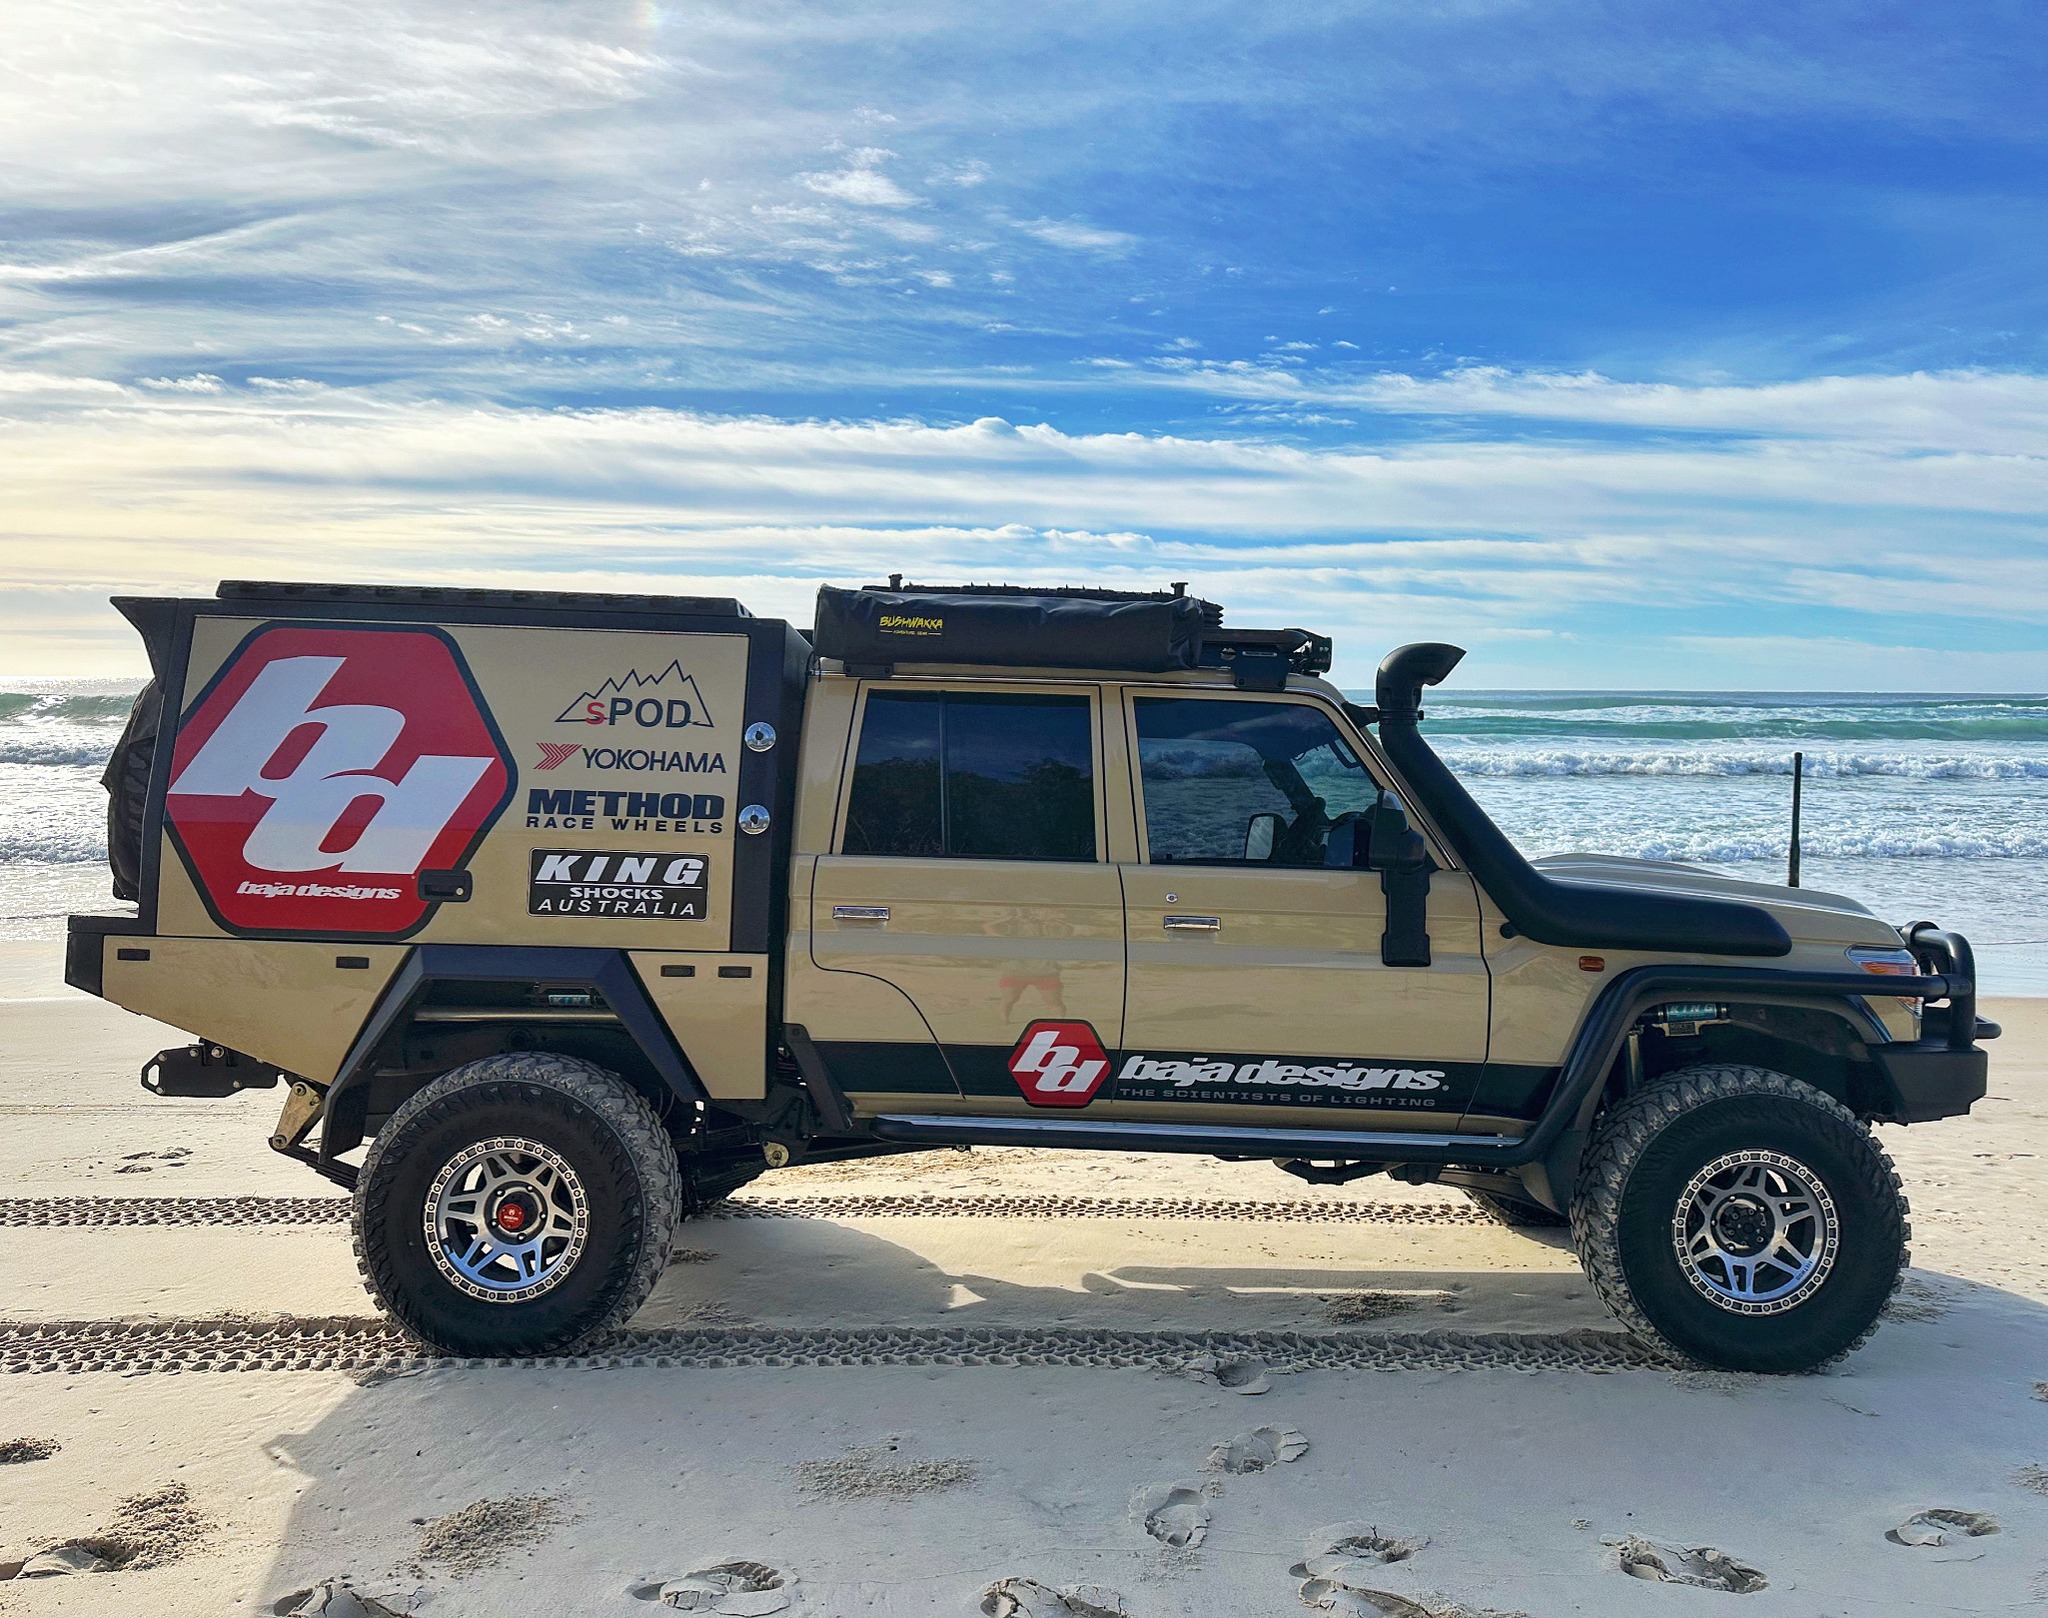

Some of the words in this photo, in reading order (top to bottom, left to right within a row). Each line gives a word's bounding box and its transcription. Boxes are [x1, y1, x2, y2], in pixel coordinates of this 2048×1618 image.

[879, 615, 943, 630] BUSHWAKKA
[582, 747, 727, 774] YOKOHAMA
[527, 788, 725, 820] METHOD
[526, 816, 594, 829] RACE
[611, 818, 723, 834] WHEELS
[534, 854, 704, 885] KING
[236, 880, 297, 898] baja
[295, 883, 402, 900] designs
[569, 887, 664, 900] SHOCKS
[537, 898, 695, 916] AUSTRALIA
[1669, 1004, 1714, 1013] KING
[1118, 1055, 1236, 1087] baja
[1120, 1088, 1156, 1097] THE
[1162, 1090, 1292, 1102] SCIENTISTS
[1299, 1094, 1324, 1102] OF
[1330, 1095, 1436, 1107] LIGHTING
